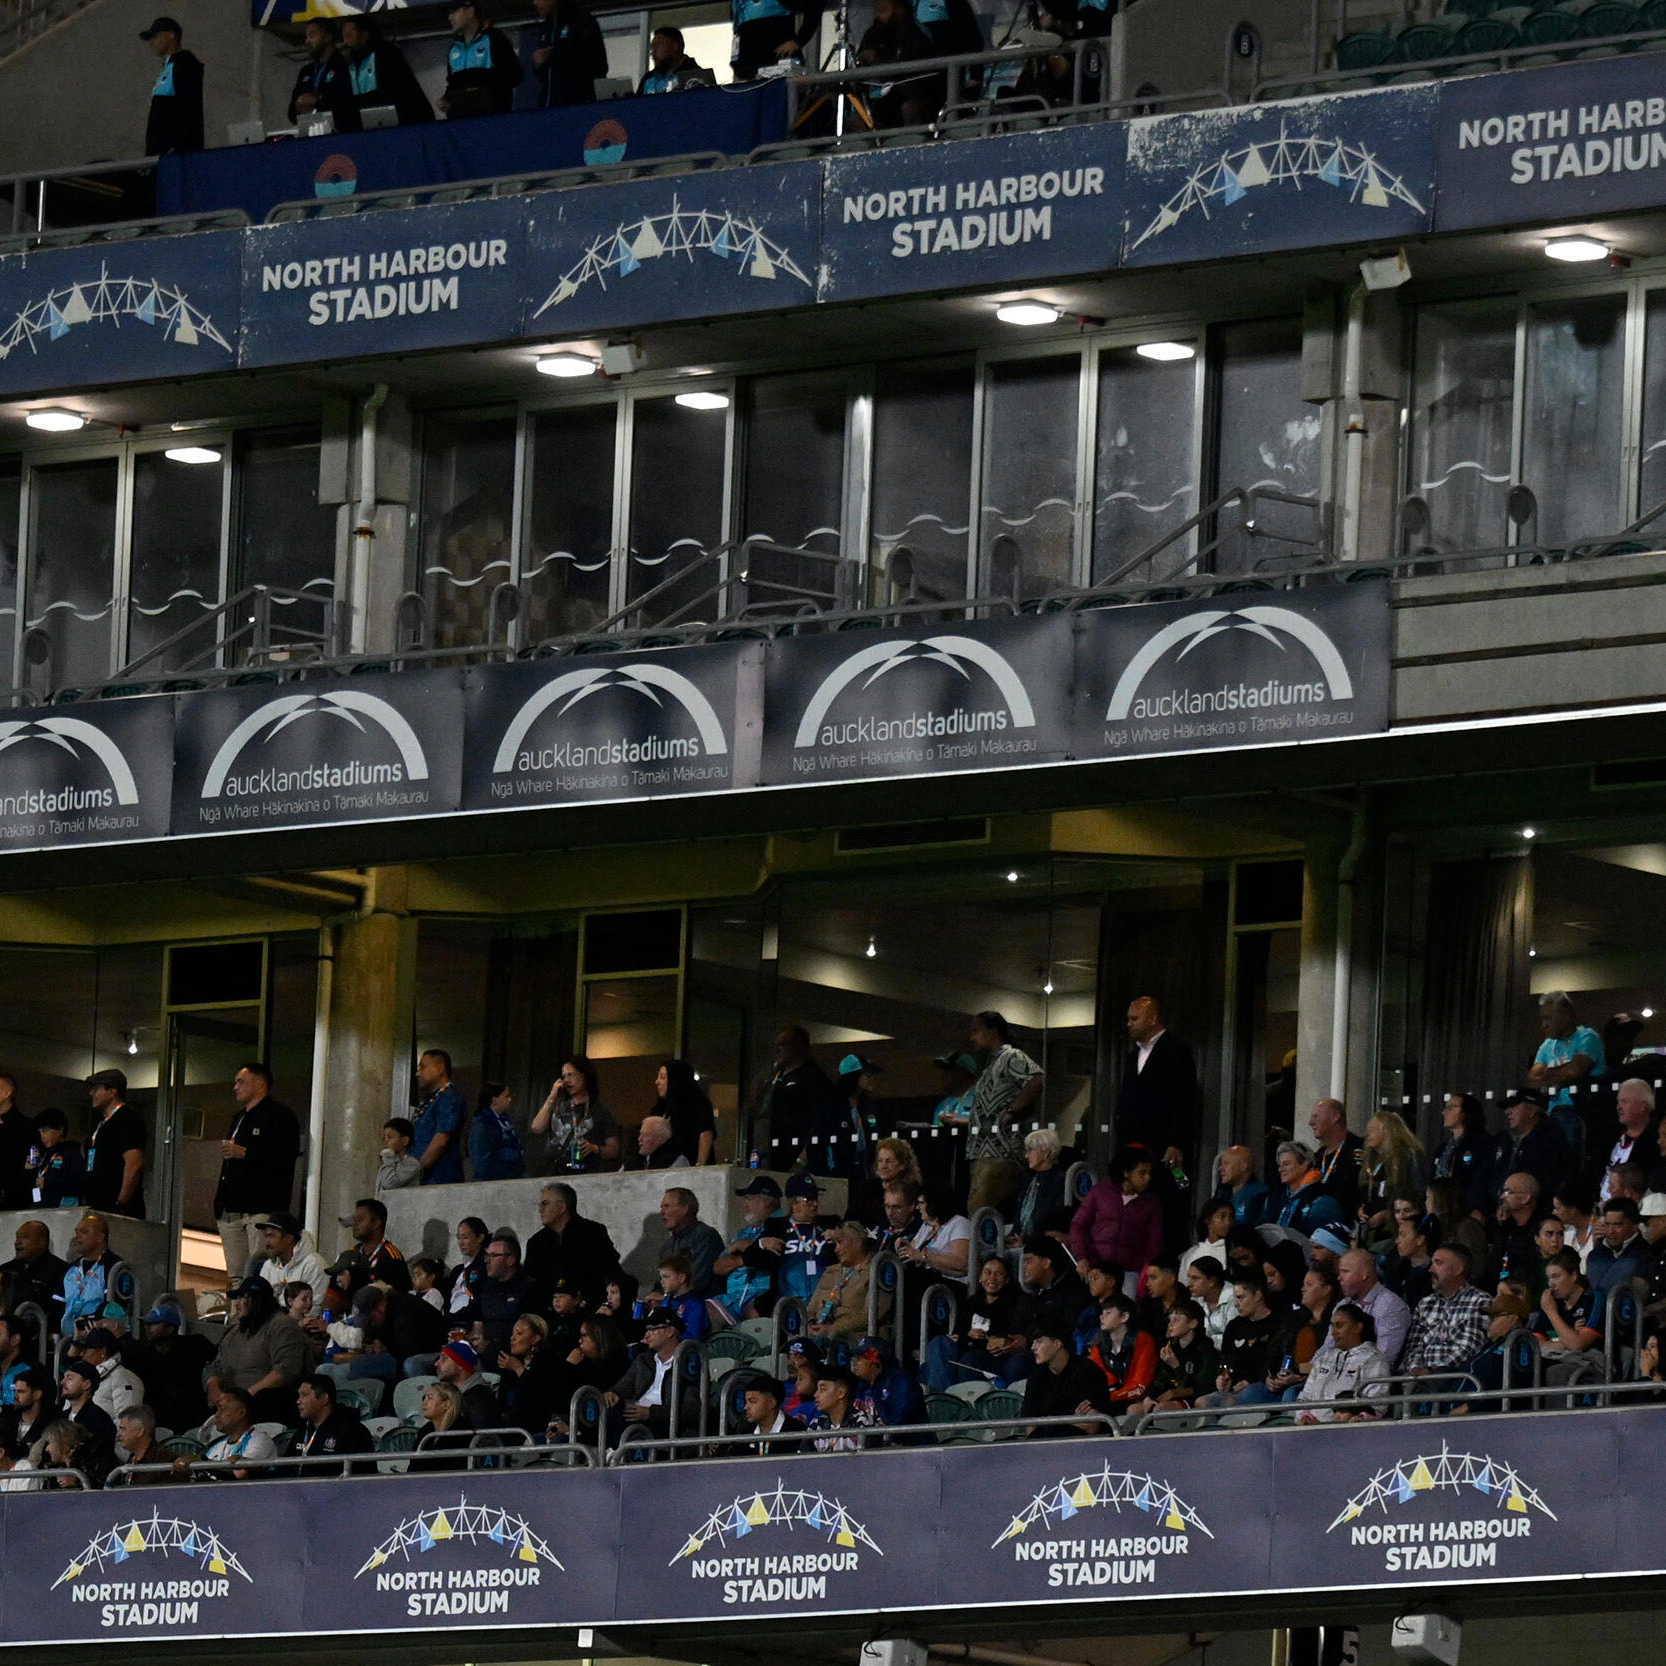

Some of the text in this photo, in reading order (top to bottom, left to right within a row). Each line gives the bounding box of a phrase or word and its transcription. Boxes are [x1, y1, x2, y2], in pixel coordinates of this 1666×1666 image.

[1459, 109, 1568, 149] NORTH
[844, 167, 1104, 223] NORTH HARBOUR
[892, 206, 1051, 257] STADIUM
[263, 240, 506, 291] NORTH HARBOUR
[309, 277, 458, 325] STADIUM
[1134, 681, 1324, 719] aucklandstadiums
[821, 709, 1007, 746] aucklandstadiums
[519, 736, 699, 771] aucklandstadiums
[226, 761, 402, 796] aucklandstadiums
[224, 804, 259, 819] Whare
[376, 791, 429, 805] Makaurau
[1352, 1518, 1530, 1545] NORTH HARBOUR
[1016, 1536, 1188, 1560] NORTH HARBOUR
[1386, 1543, 1496, 1571] STADIUM
[377, 1568, 540, 1591] NORTH HARBOUR
[692, 1553, 858, 1578] NORTH HARBOUR
[1048, 1560, 1155, 1586] STADIUM
[73, 1579, 229, 1602] NORTH HARBOUR
[408, 1591, 508, 1616] STADIUM
[723, 1576, 825, 1603] STADIUM
[101, 1602, 198, 1626] STADIUM
